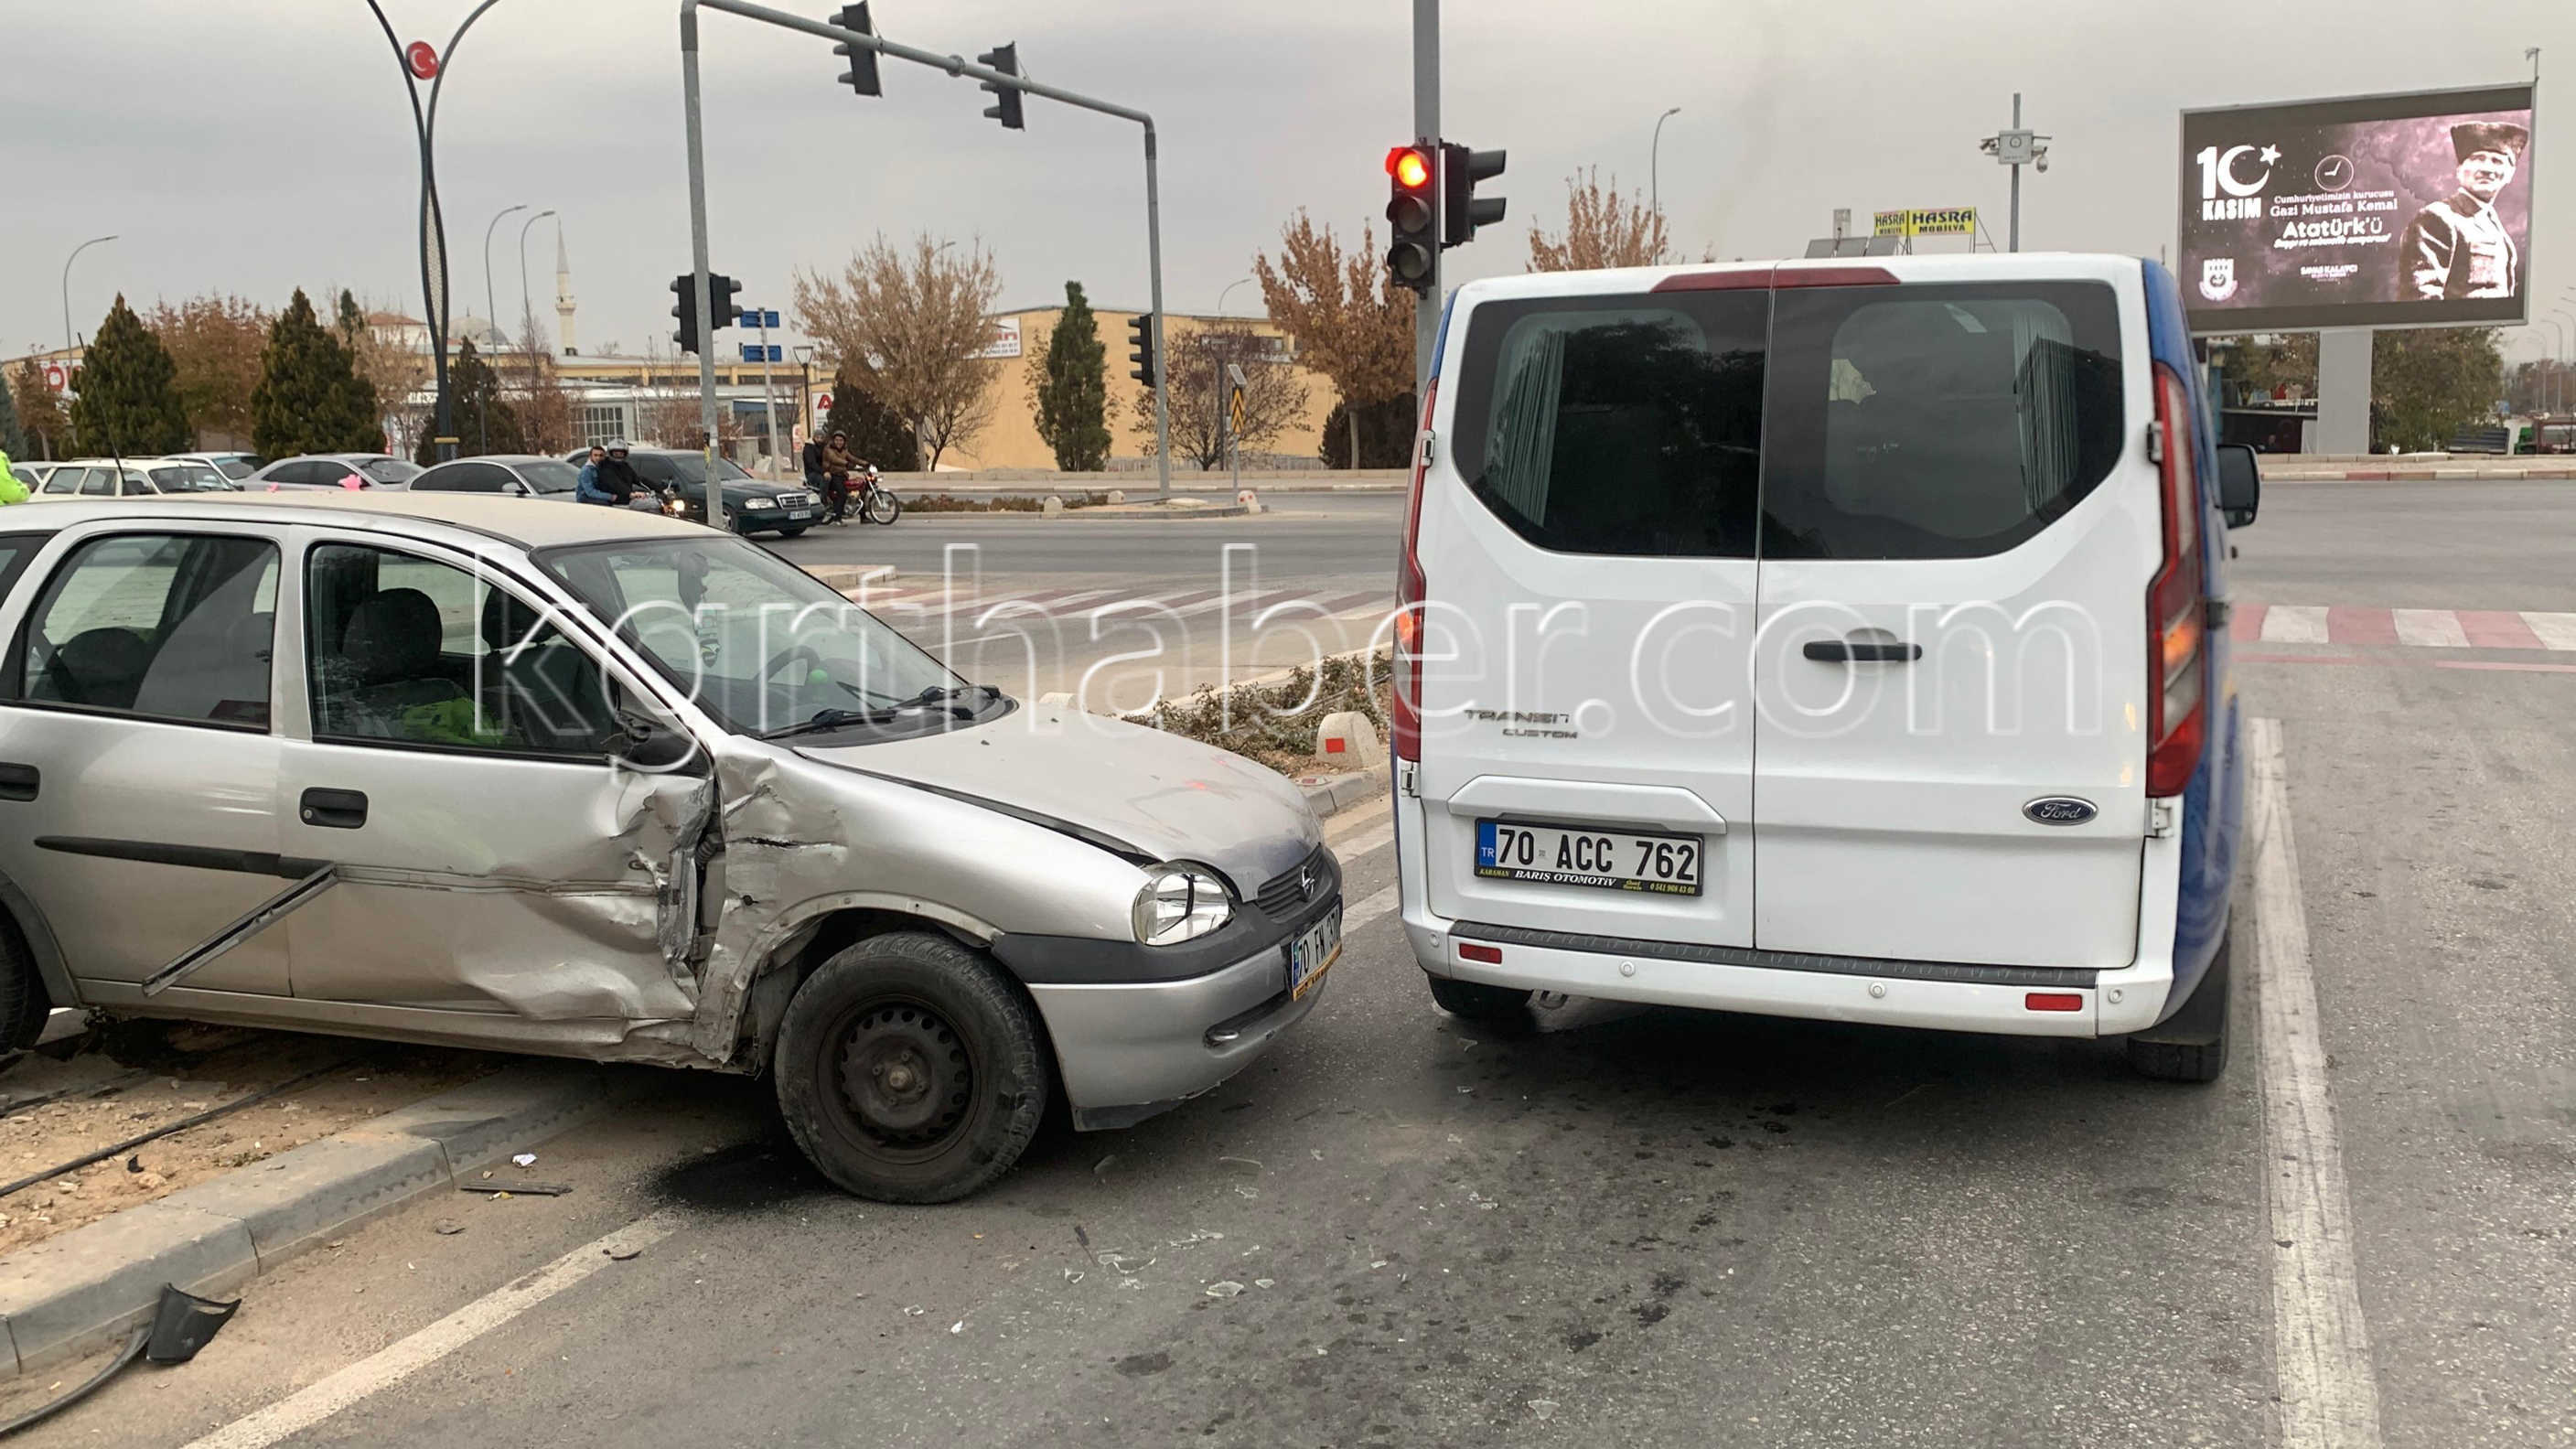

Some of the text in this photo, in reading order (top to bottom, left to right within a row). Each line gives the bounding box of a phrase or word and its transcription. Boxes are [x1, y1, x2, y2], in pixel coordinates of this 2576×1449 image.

[2353, 190, 2394, 200] kurucusu
[2202, 198, 2261, 220] KASIM
[2270, 199, 2398, 217] Gazi Mustafa Kemal
[1875, 213, 1905, 228] HASRA
[1912, 210, 1972, 225] HASRA
[1502, 728, 1578, 739] CUSTOM
[2040, 802, 2081, 820] Ford
[1481, 847, 1495, 858] TR
[1499, 829, 1694, 880] 70 ACC 762
[1515, 870, 1551, 881] BARIŞ
[1298, 939, 1309, 979] 70
